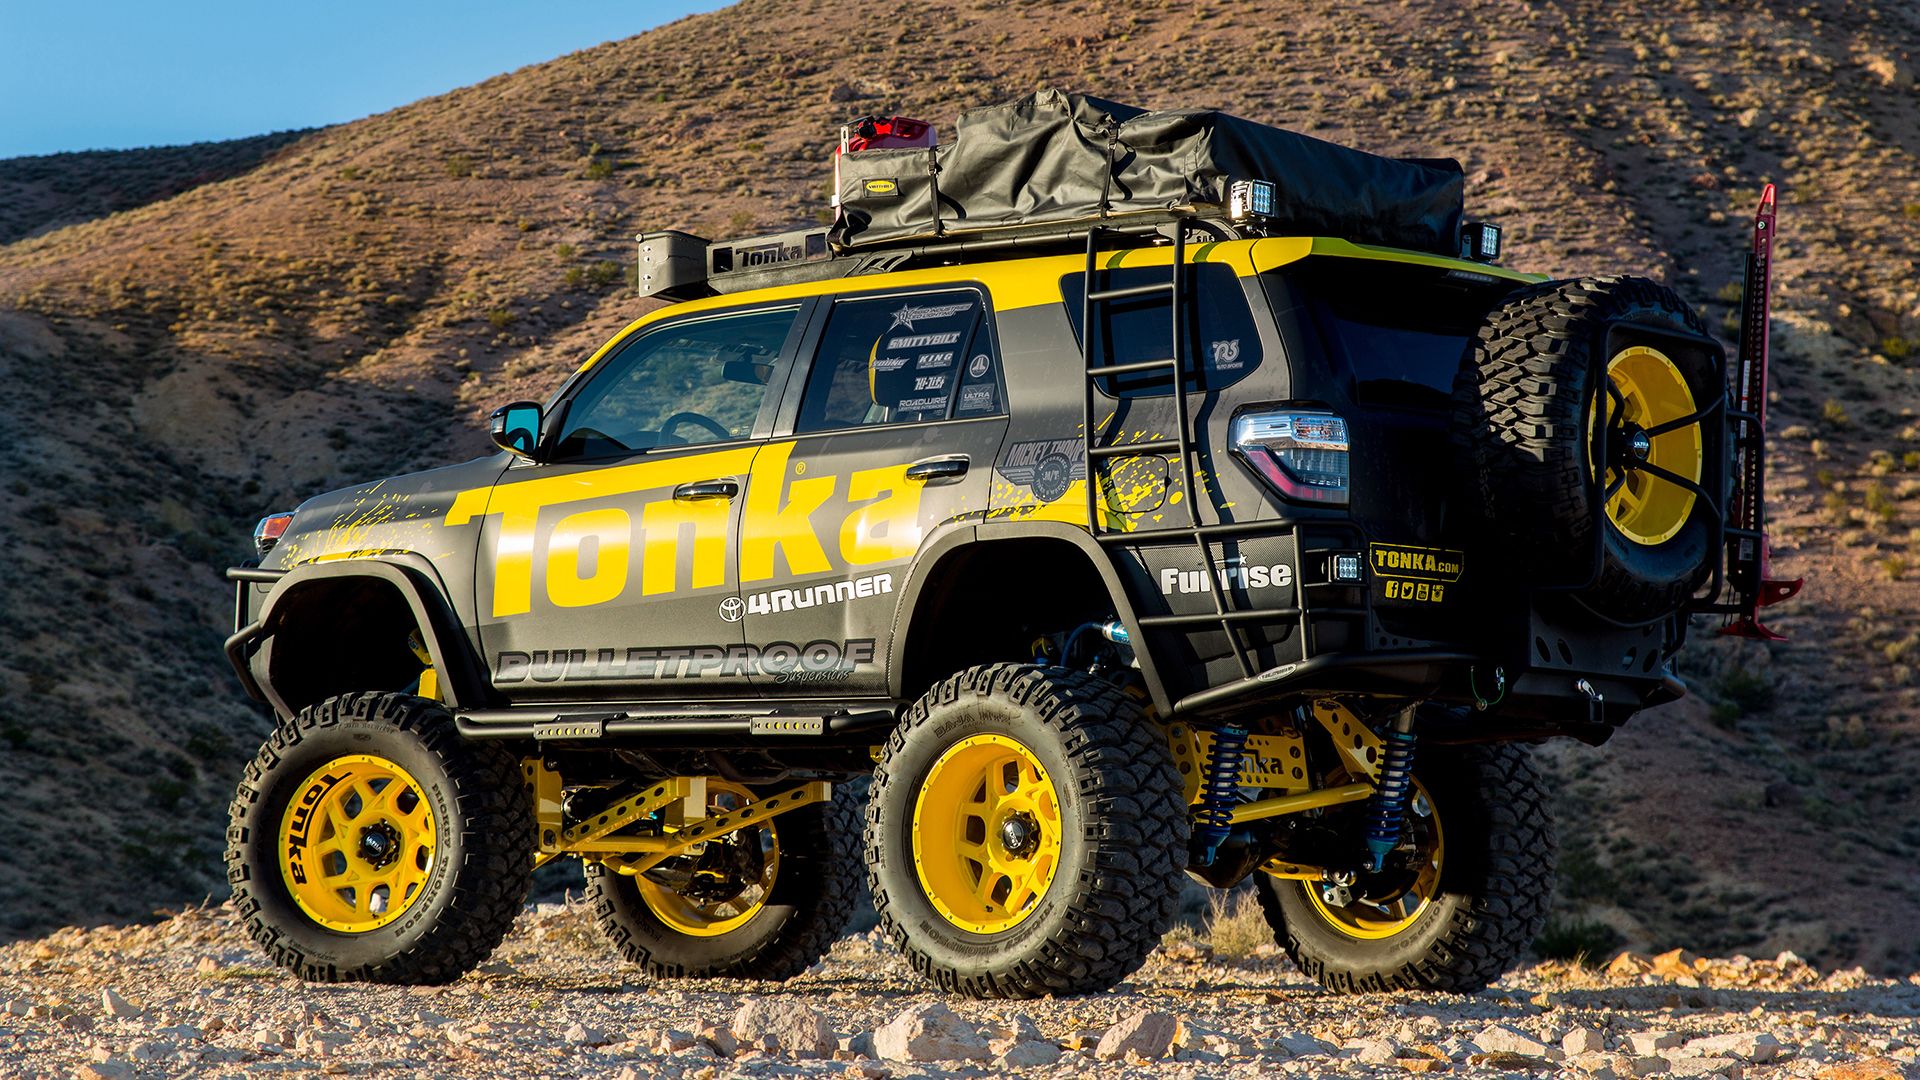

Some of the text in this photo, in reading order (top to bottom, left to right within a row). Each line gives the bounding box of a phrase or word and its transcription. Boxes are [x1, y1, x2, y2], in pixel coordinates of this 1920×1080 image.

[736, 242, 802, 267] Tonka
[888, 333, 961, 349] SMITTYBILT
[919, 352, 953, 363] KING
[900, 395, 948, 407] ROADWIRE
[964, 391, 990, 399] ULTRA
[1004, 441, 1051, 467] MICKEY
[443, 441, 923, 618] Tonka
[498, 637, 876, 684] BULLETPROOF
[775, 664, 850, 684] Suspensions
[288, 771, 353, 885] Tonka
